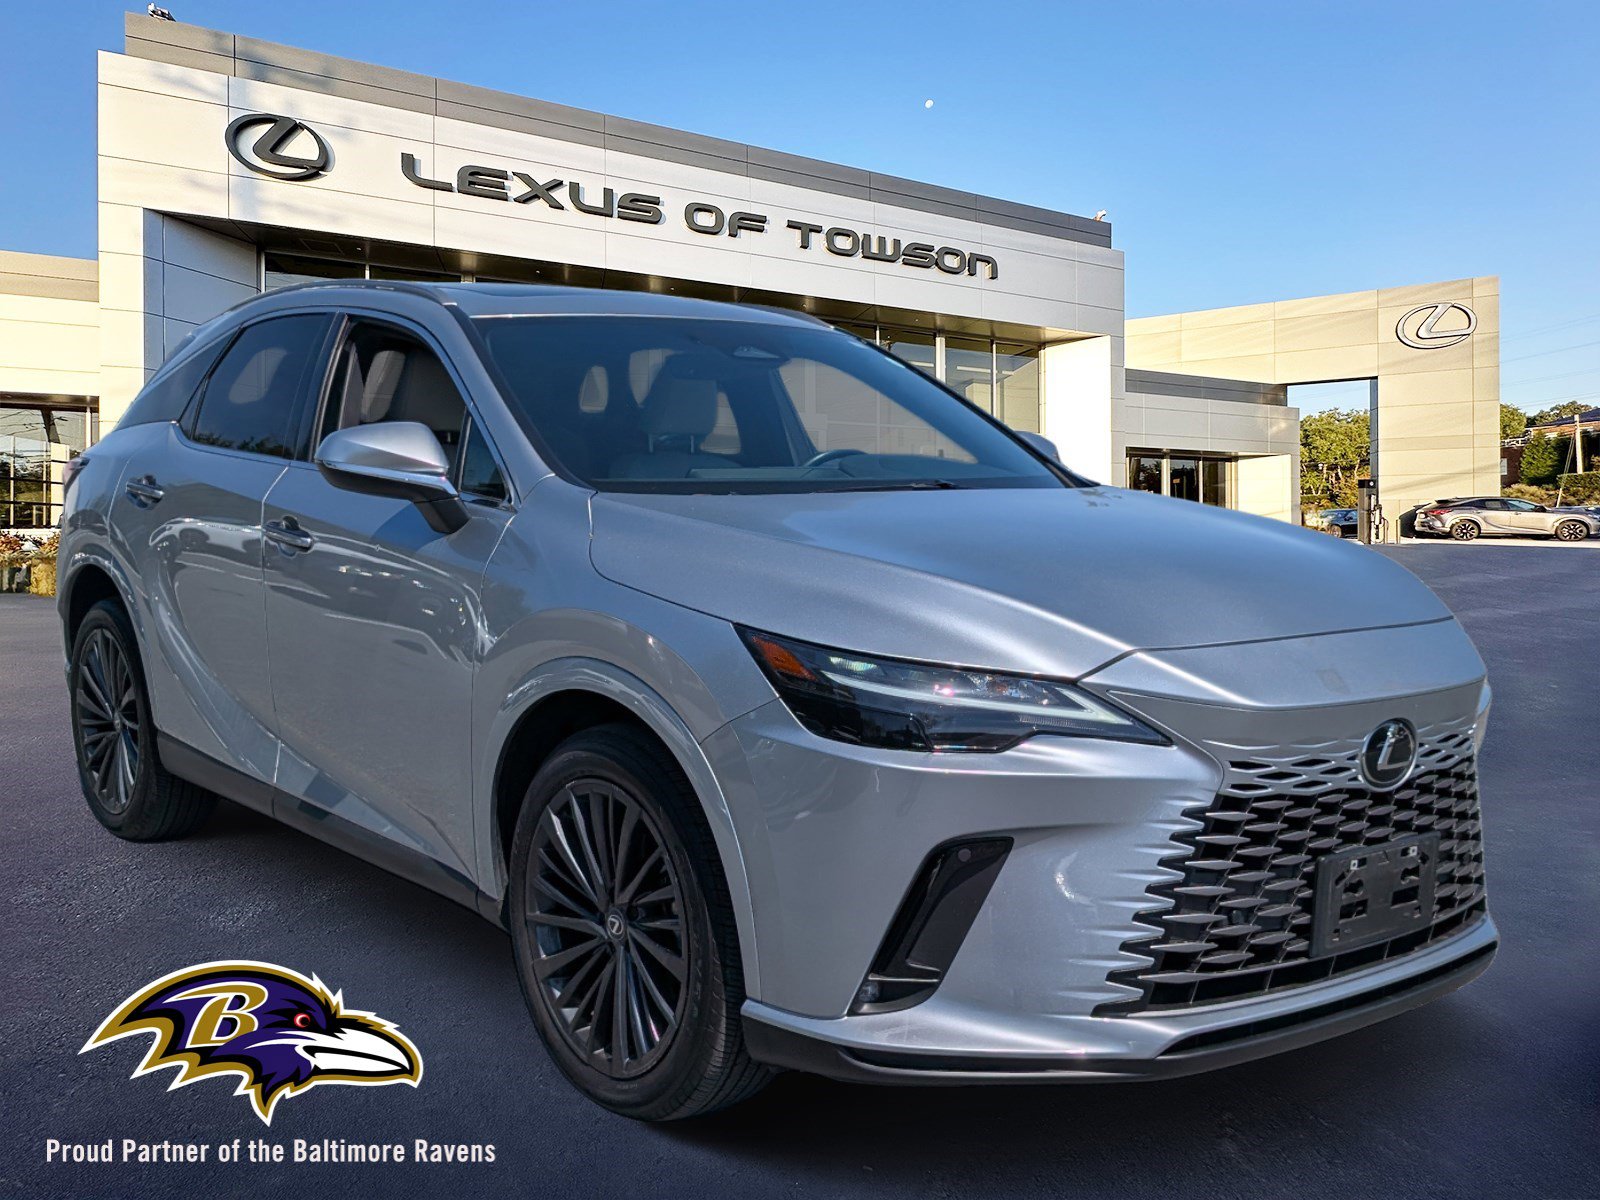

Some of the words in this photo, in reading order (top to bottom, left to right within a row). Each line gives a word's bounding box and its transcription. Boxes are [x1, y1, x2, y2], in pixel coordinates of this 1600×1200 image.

[400, 152, 662, 225] LEXUS
[684, 202, 767, 237] OF
[786, 219, 999, 280] TOWSON
